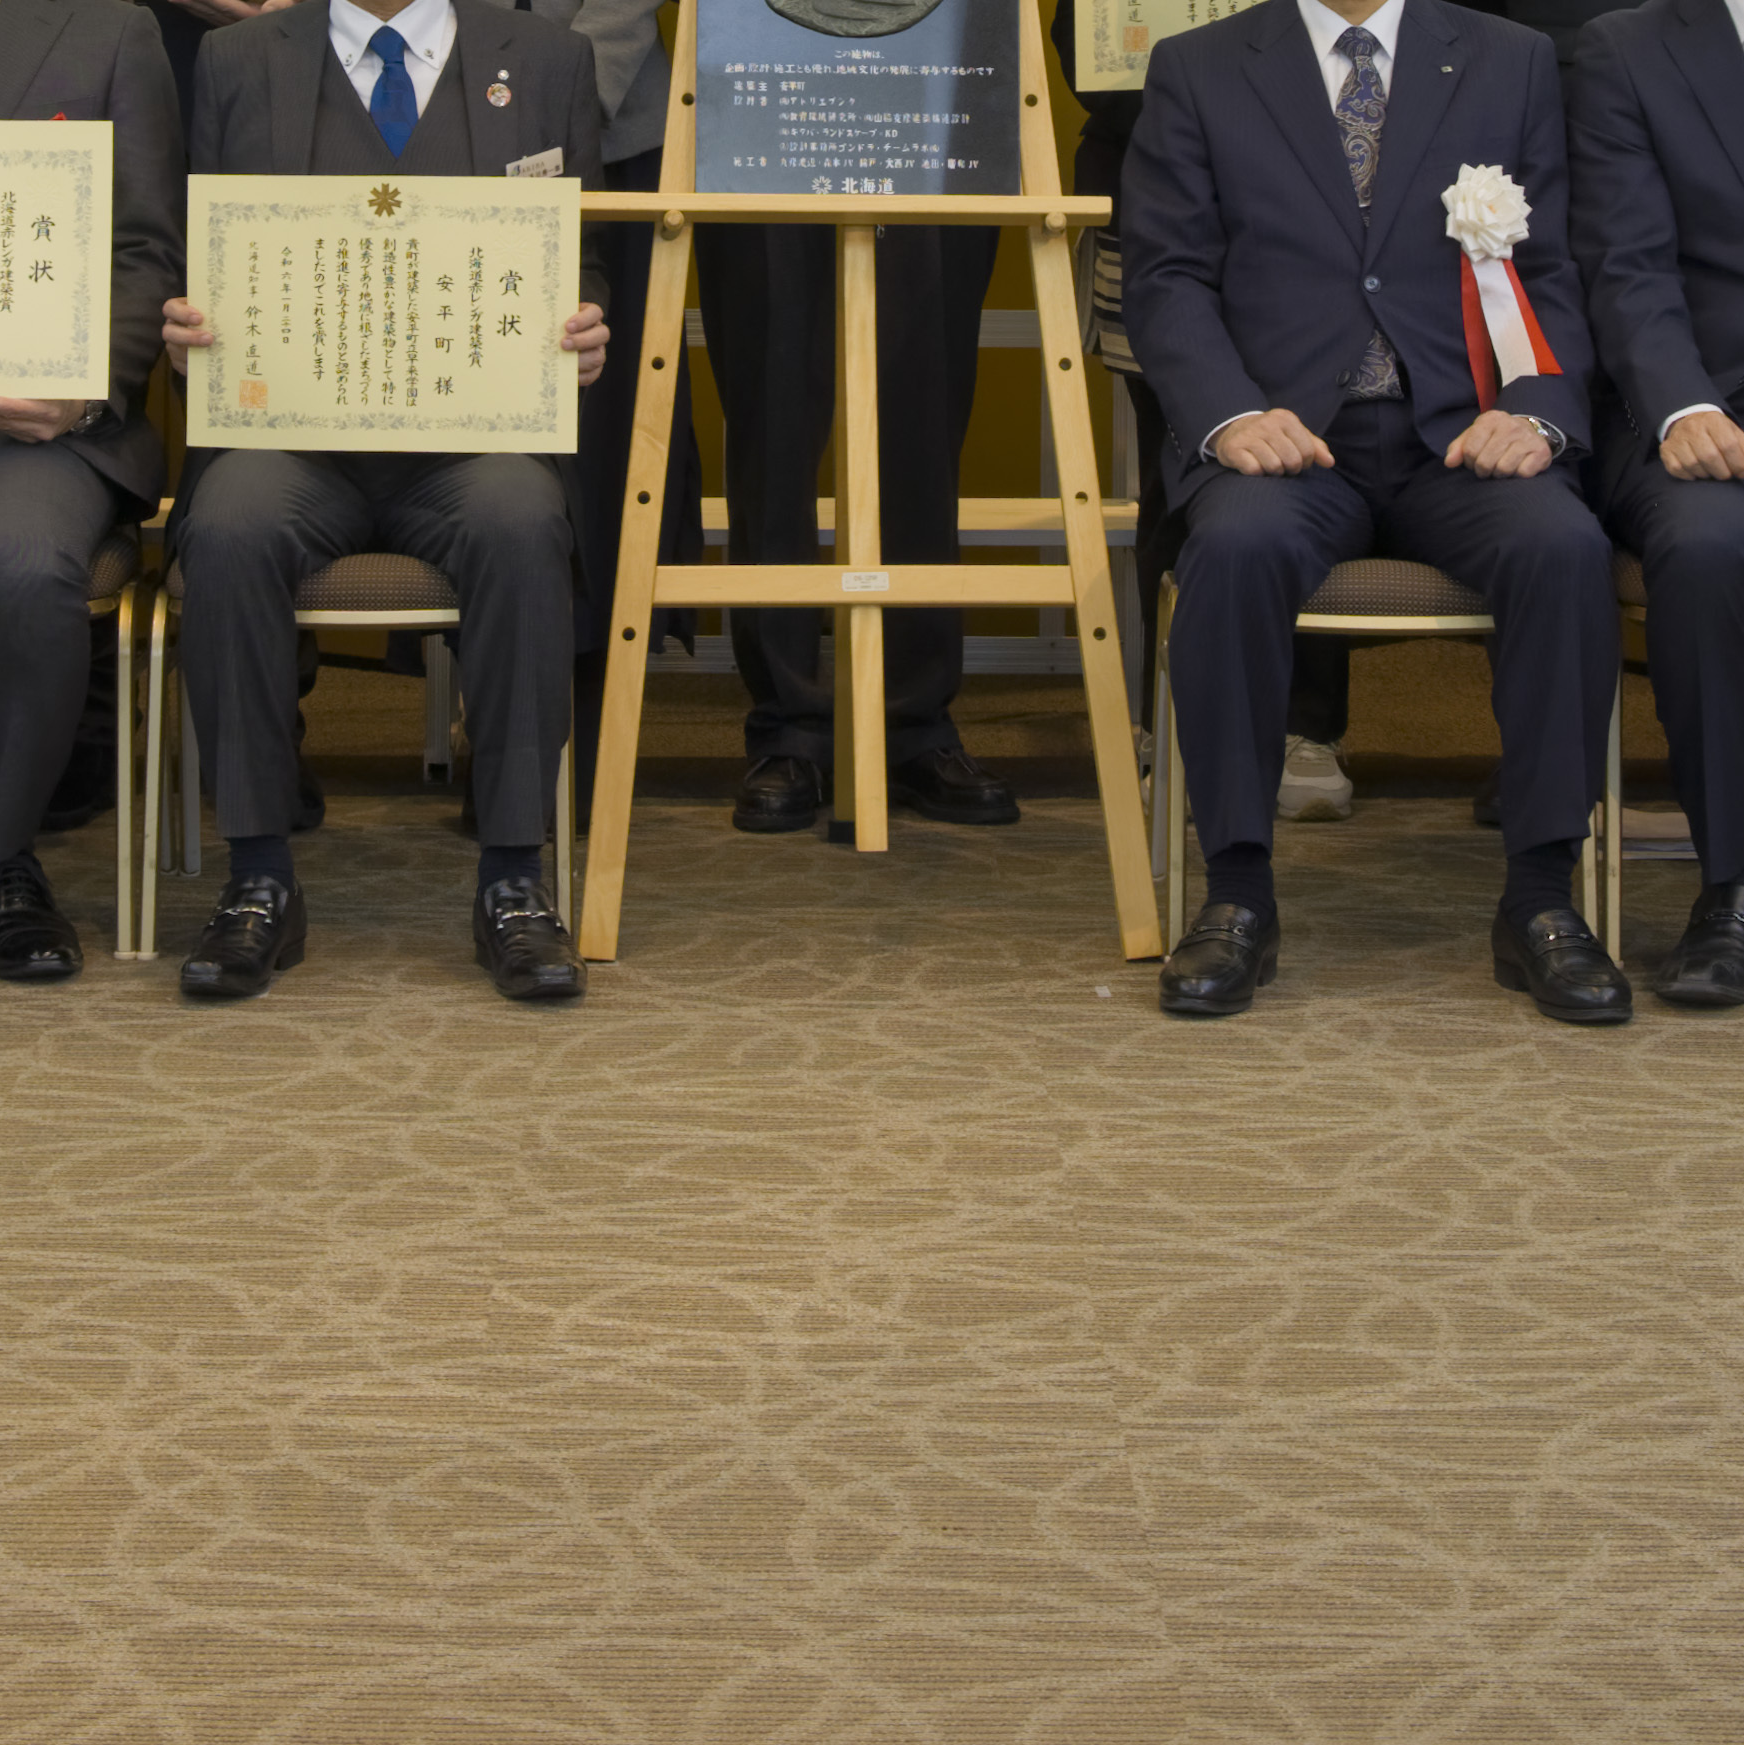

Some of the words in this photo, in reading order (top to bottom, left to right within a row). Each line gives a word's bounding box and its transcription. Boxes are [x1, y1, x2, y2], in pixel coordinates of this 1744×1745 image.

[841, 176, 895, 194] 北海道
[28, 214, 56, 283] 賞状
[468, 247, 484, 368] 北海道赤レンガ建築賞
[496, 269, 523, 337] 賞状
